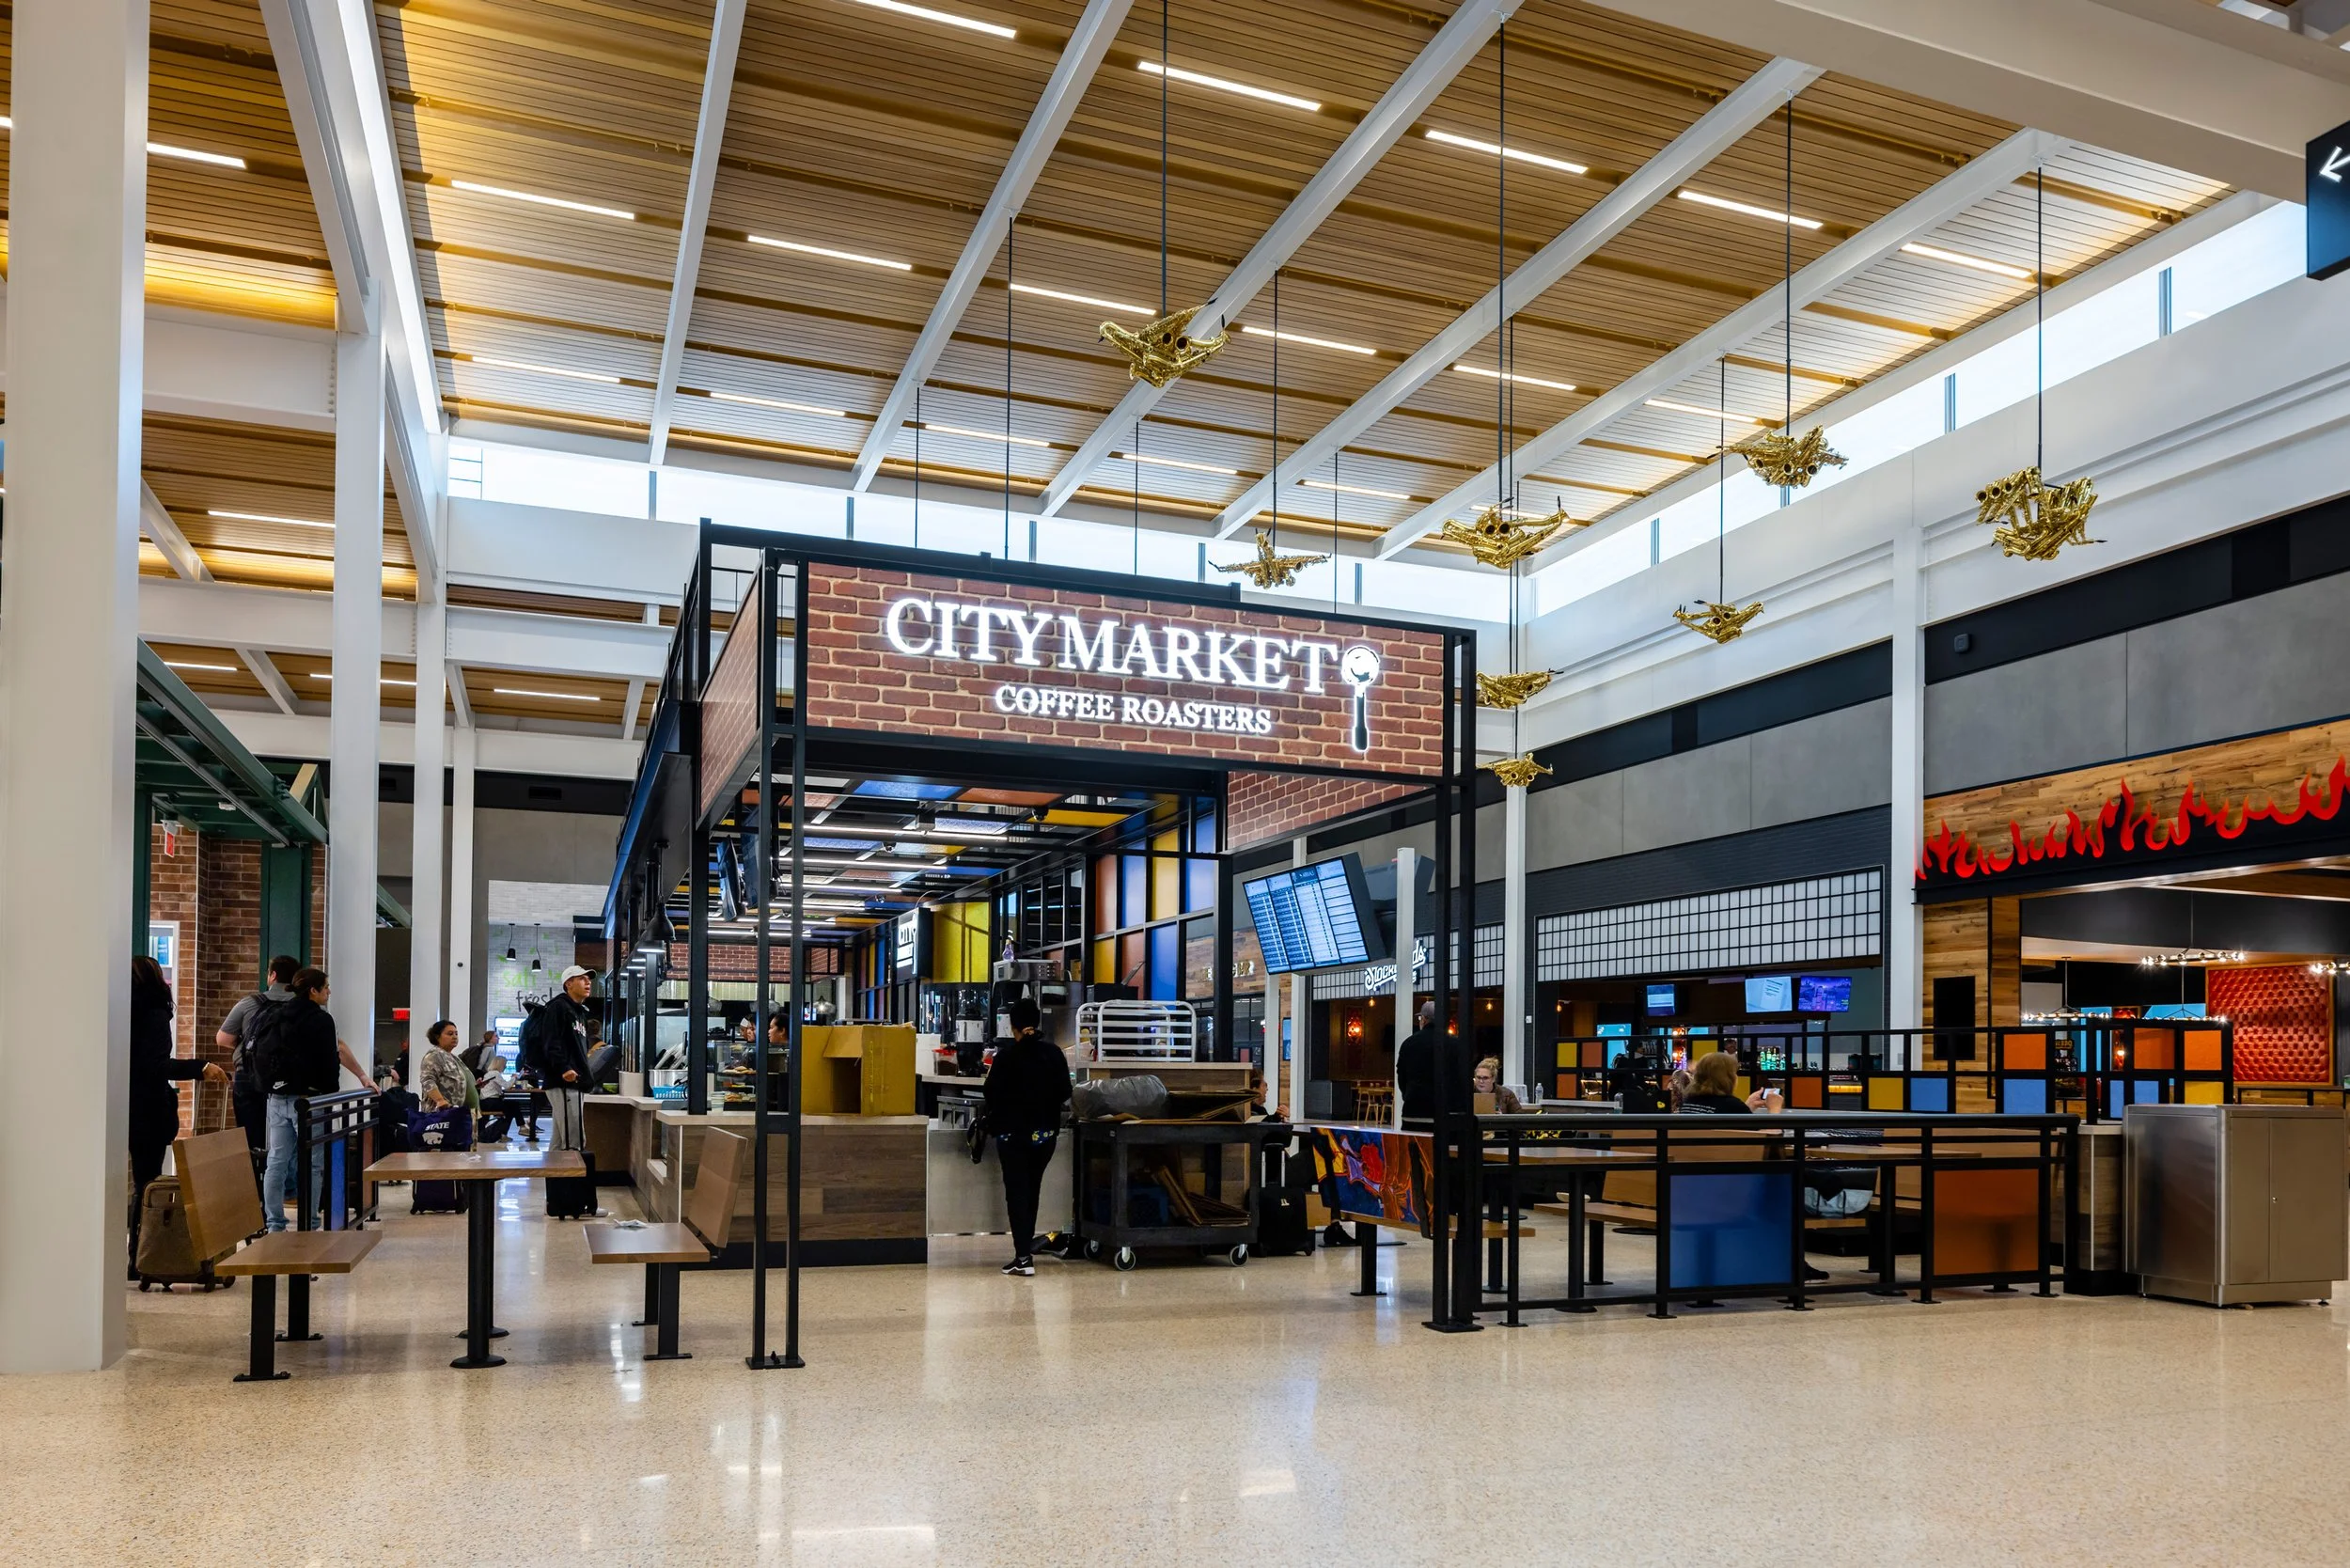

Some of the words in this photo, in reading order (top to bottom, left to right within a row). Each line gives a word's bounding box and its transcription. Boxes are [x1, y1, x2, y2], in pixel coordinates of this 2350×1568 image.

[886, 598, 1054, 666] CITY
[1058, 614, 1339, 694] MARKET
[995, 684, 1115, 721] COFFEE
[1120, 695, 1272, 734] ROASTERS
[425, 1121, 450, 1131] STATE
